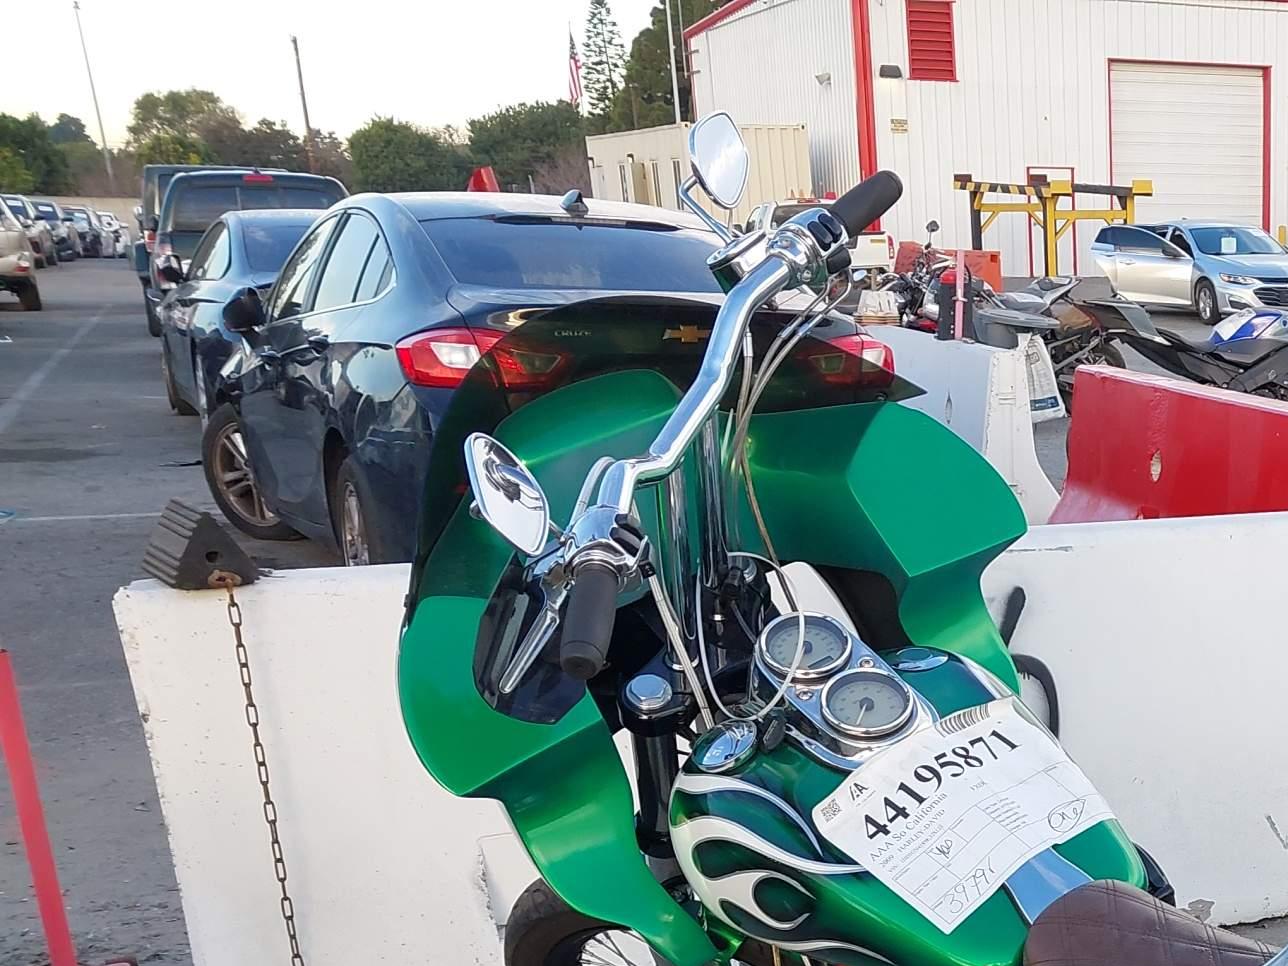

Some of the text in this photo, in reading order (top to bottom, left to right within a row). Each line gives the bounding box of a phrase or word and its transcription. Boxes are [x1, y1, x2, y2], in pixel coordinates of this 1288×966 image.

[863, 729, 1022, 844] 44195871
[870, 842, 894, 862] AAA
[892, 830, 907, 842] So
[905, 792, 948, 831] California
